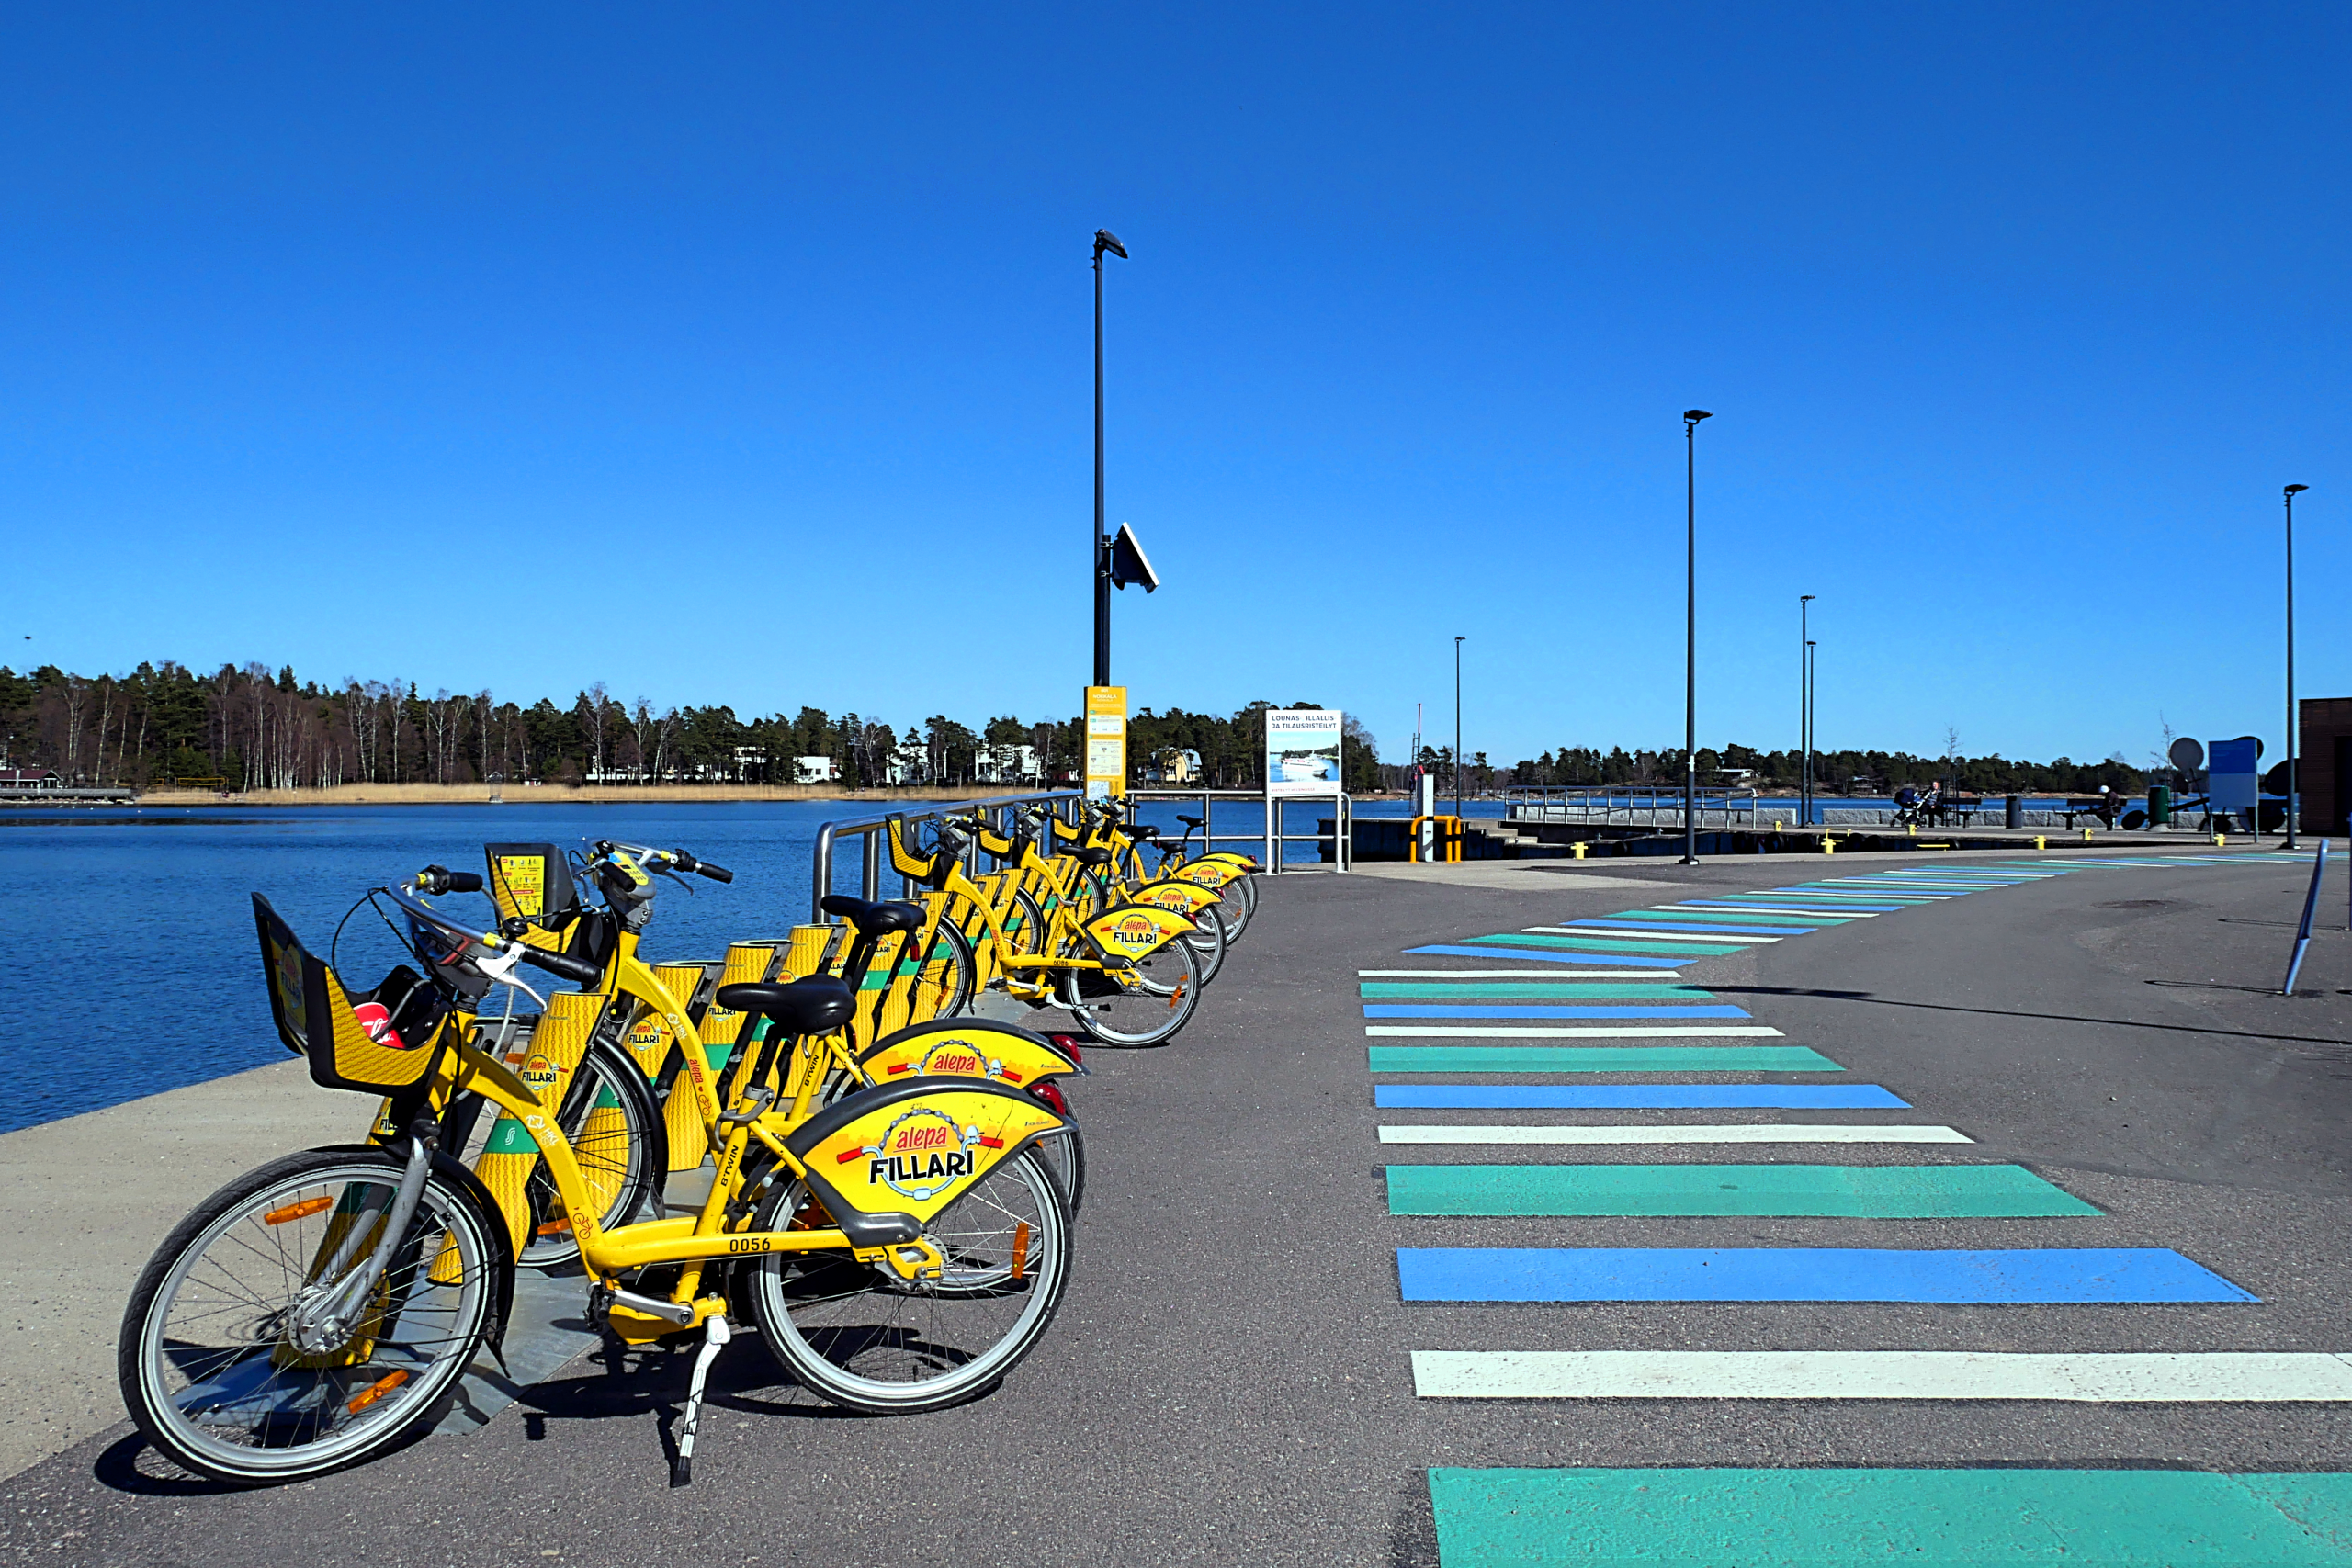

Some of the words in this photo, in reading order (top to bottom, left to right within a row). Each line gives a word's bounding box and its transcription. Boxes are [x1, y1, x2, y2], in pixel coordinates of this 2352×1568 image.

[1193, 876, 1221, 885] FILLARI
[1162, 893, 1182, 901] alepa
[1125, 919, 1147, 931] alepa
[1113, 931, 1158, 944] FILLARI
[636, 1024, 650, 1033] alepa
[628, 1034, 660, 1044] FILLARI
[529, 1060, 547, 1070] alepa
[933, 1053, 976, 1073] alepa
[522, 1071, 557, 1082] FILLARI
[689, 1058, 704, 1084] alepa
[543, 1127, 560, 1146] HKL
[896, 1126, 947, 1150] alepa
[869, 1150, 974, 1184] FILLARI
[729, 1237, 771, 1252] 0056
